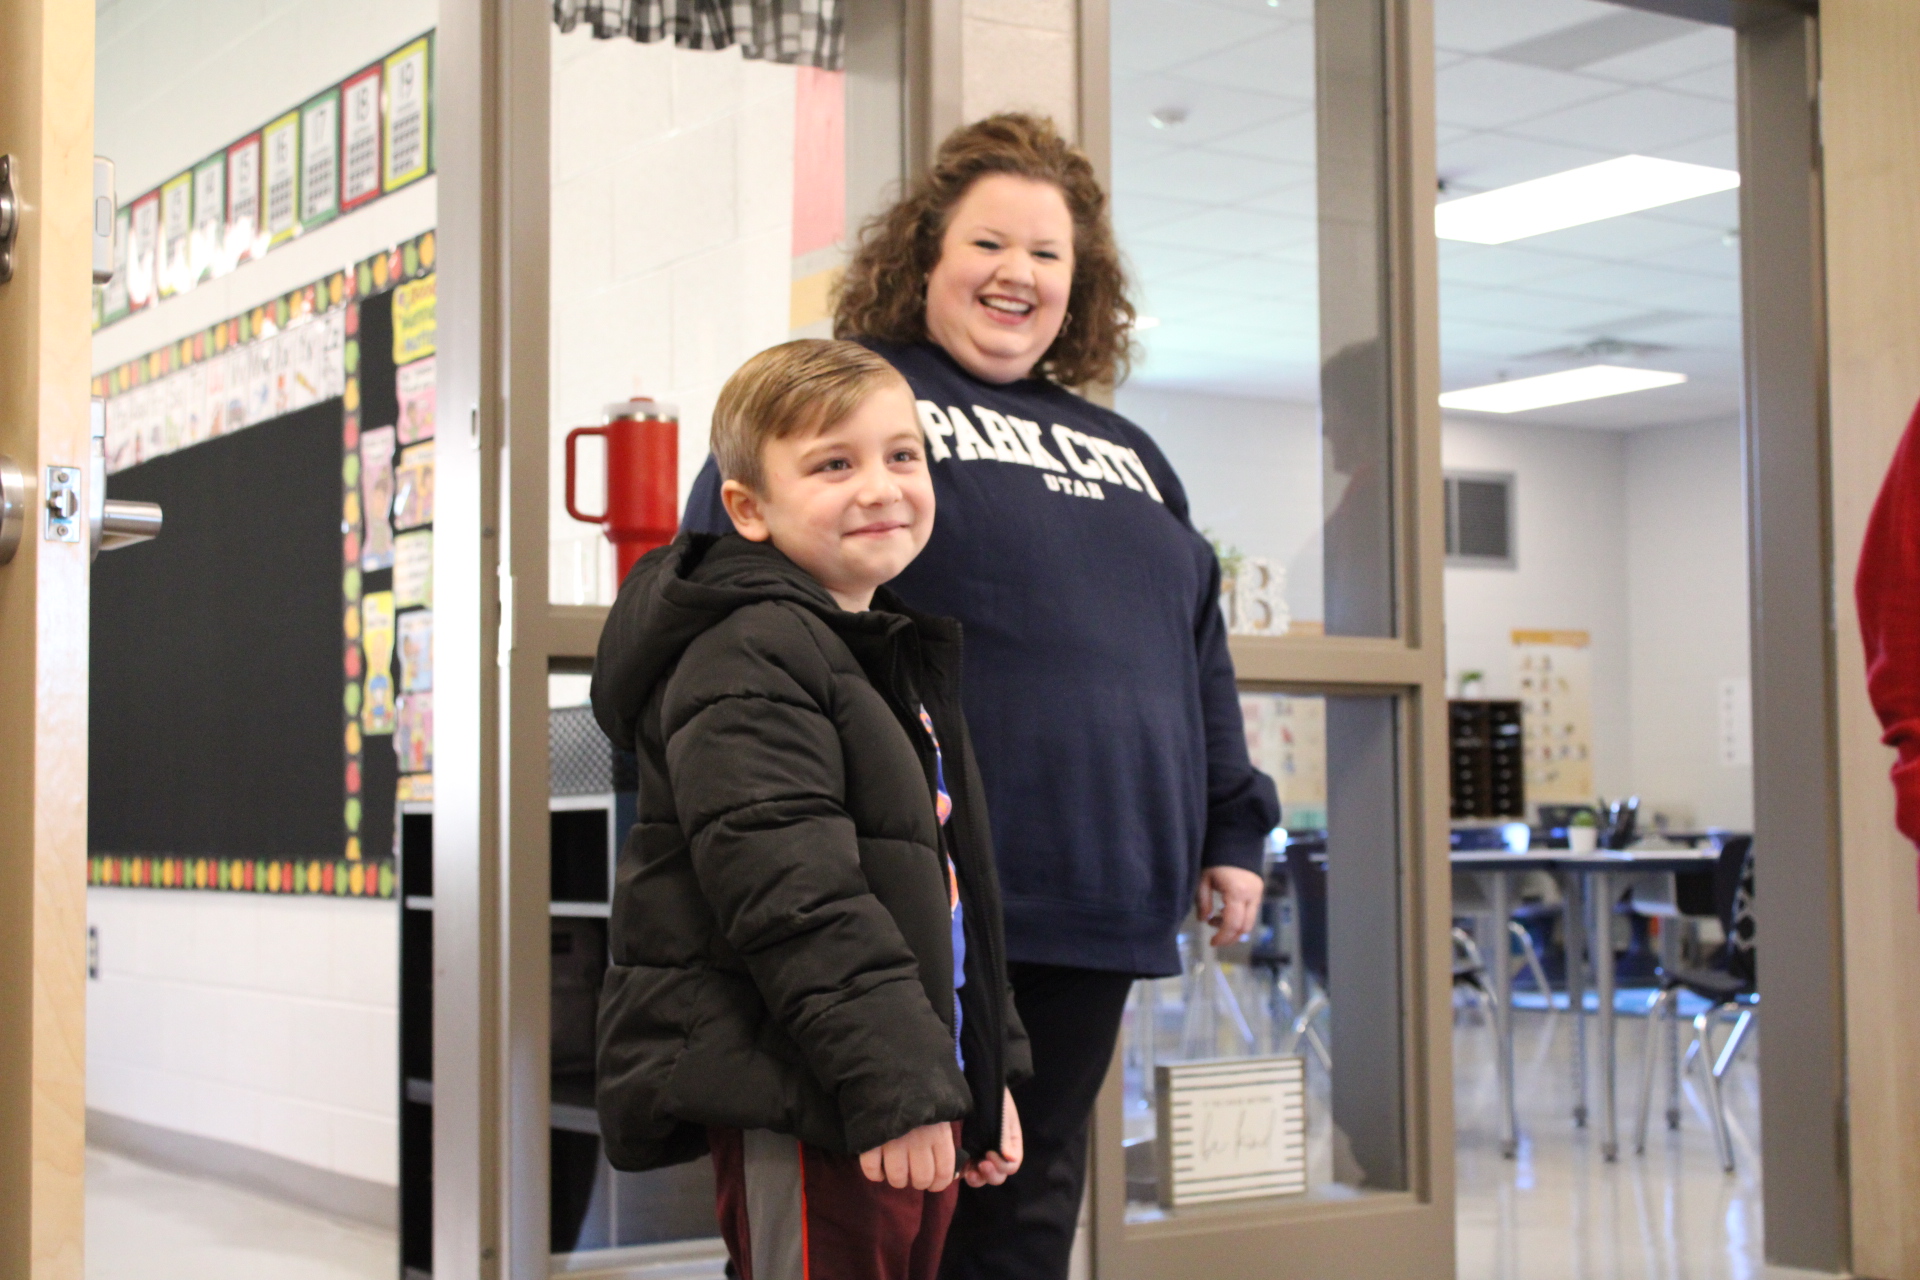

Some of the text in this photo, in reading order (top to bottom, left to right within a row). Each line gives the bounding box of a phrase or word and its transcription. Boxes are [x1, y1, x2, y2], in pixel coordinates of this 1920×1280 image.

[398, 62, 415, 98] 19
[311, 109, 327, 144] 17
[915, 399, 1165, 504] PARK CITY
[1042, 473, 1105, 500] UTAH
